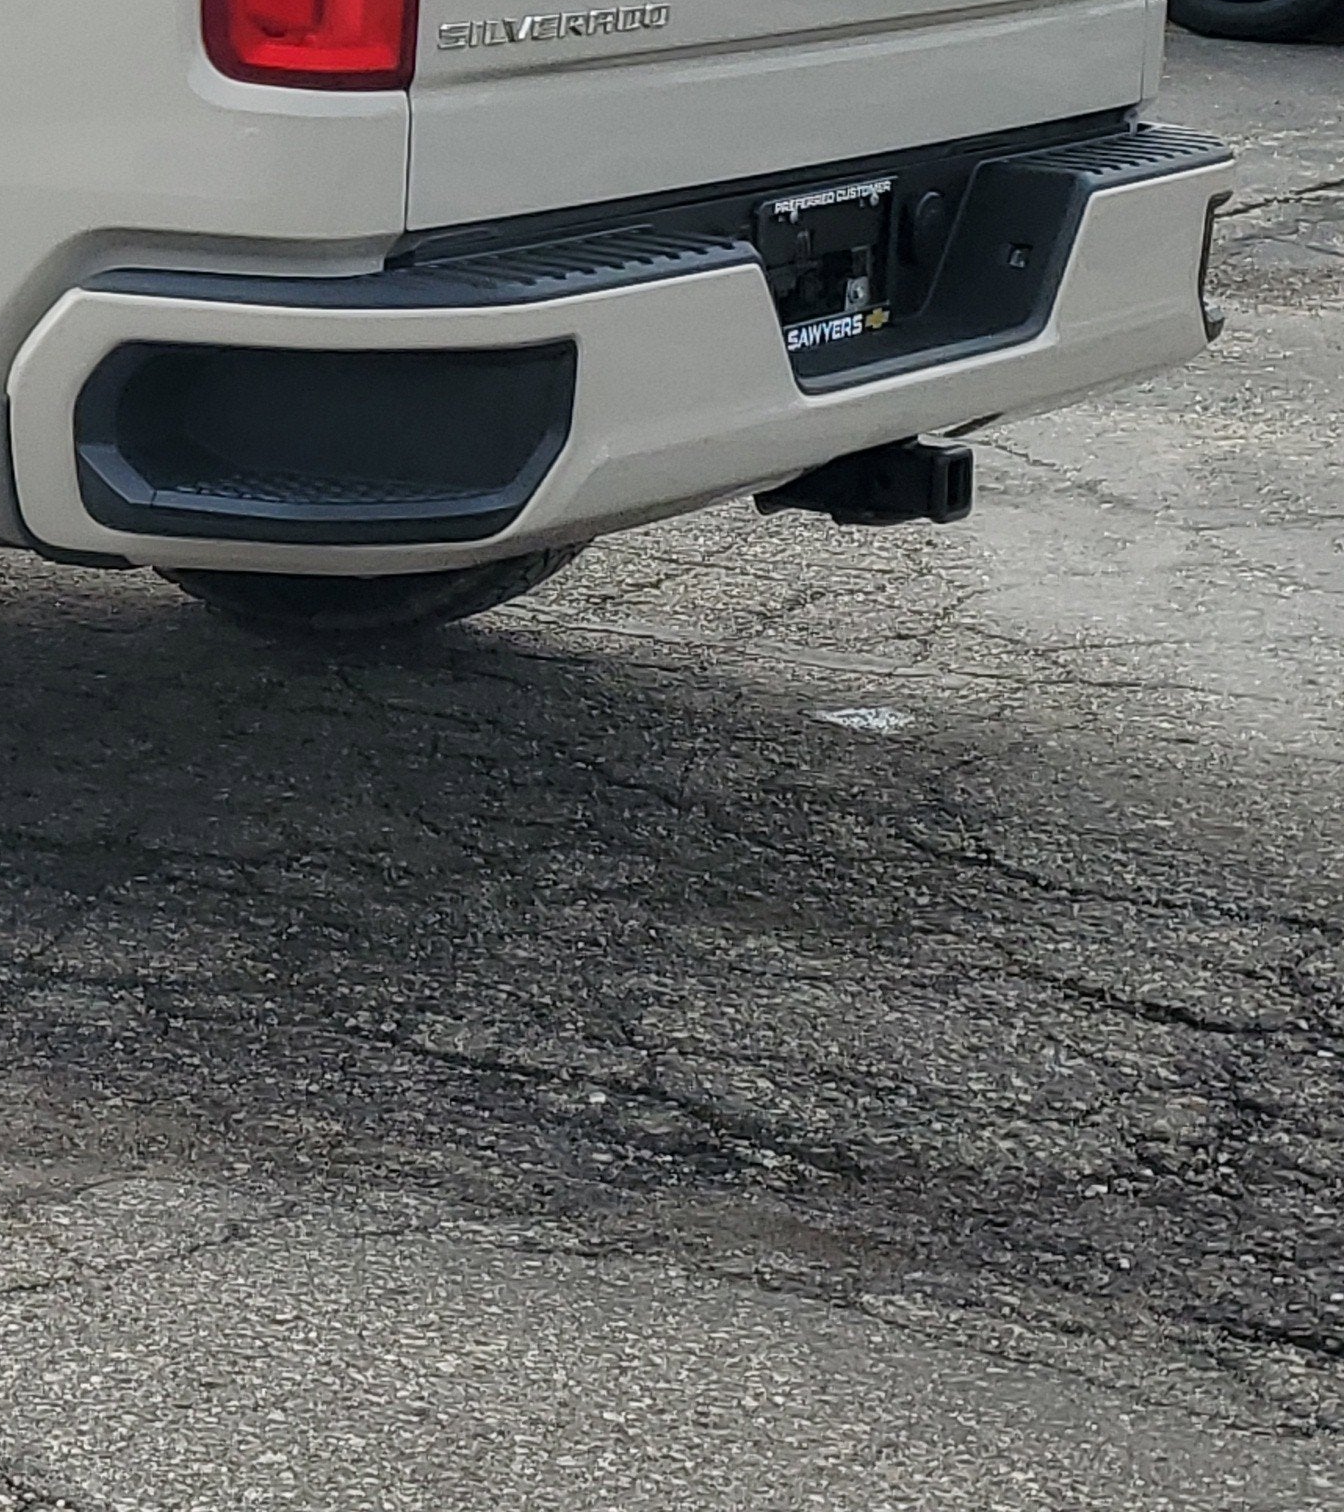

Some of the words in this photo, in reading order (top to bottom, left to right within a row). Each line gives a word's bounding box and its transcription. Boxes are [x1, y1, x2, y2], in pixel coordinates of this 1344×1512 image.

[437, 2, 672, 50] SILVERADO
[774, 192, 835, 214] PREFERRED
[836, 180, 892, 201] CUSTOMER
[787, 313, 863, 351] SAWYERS
